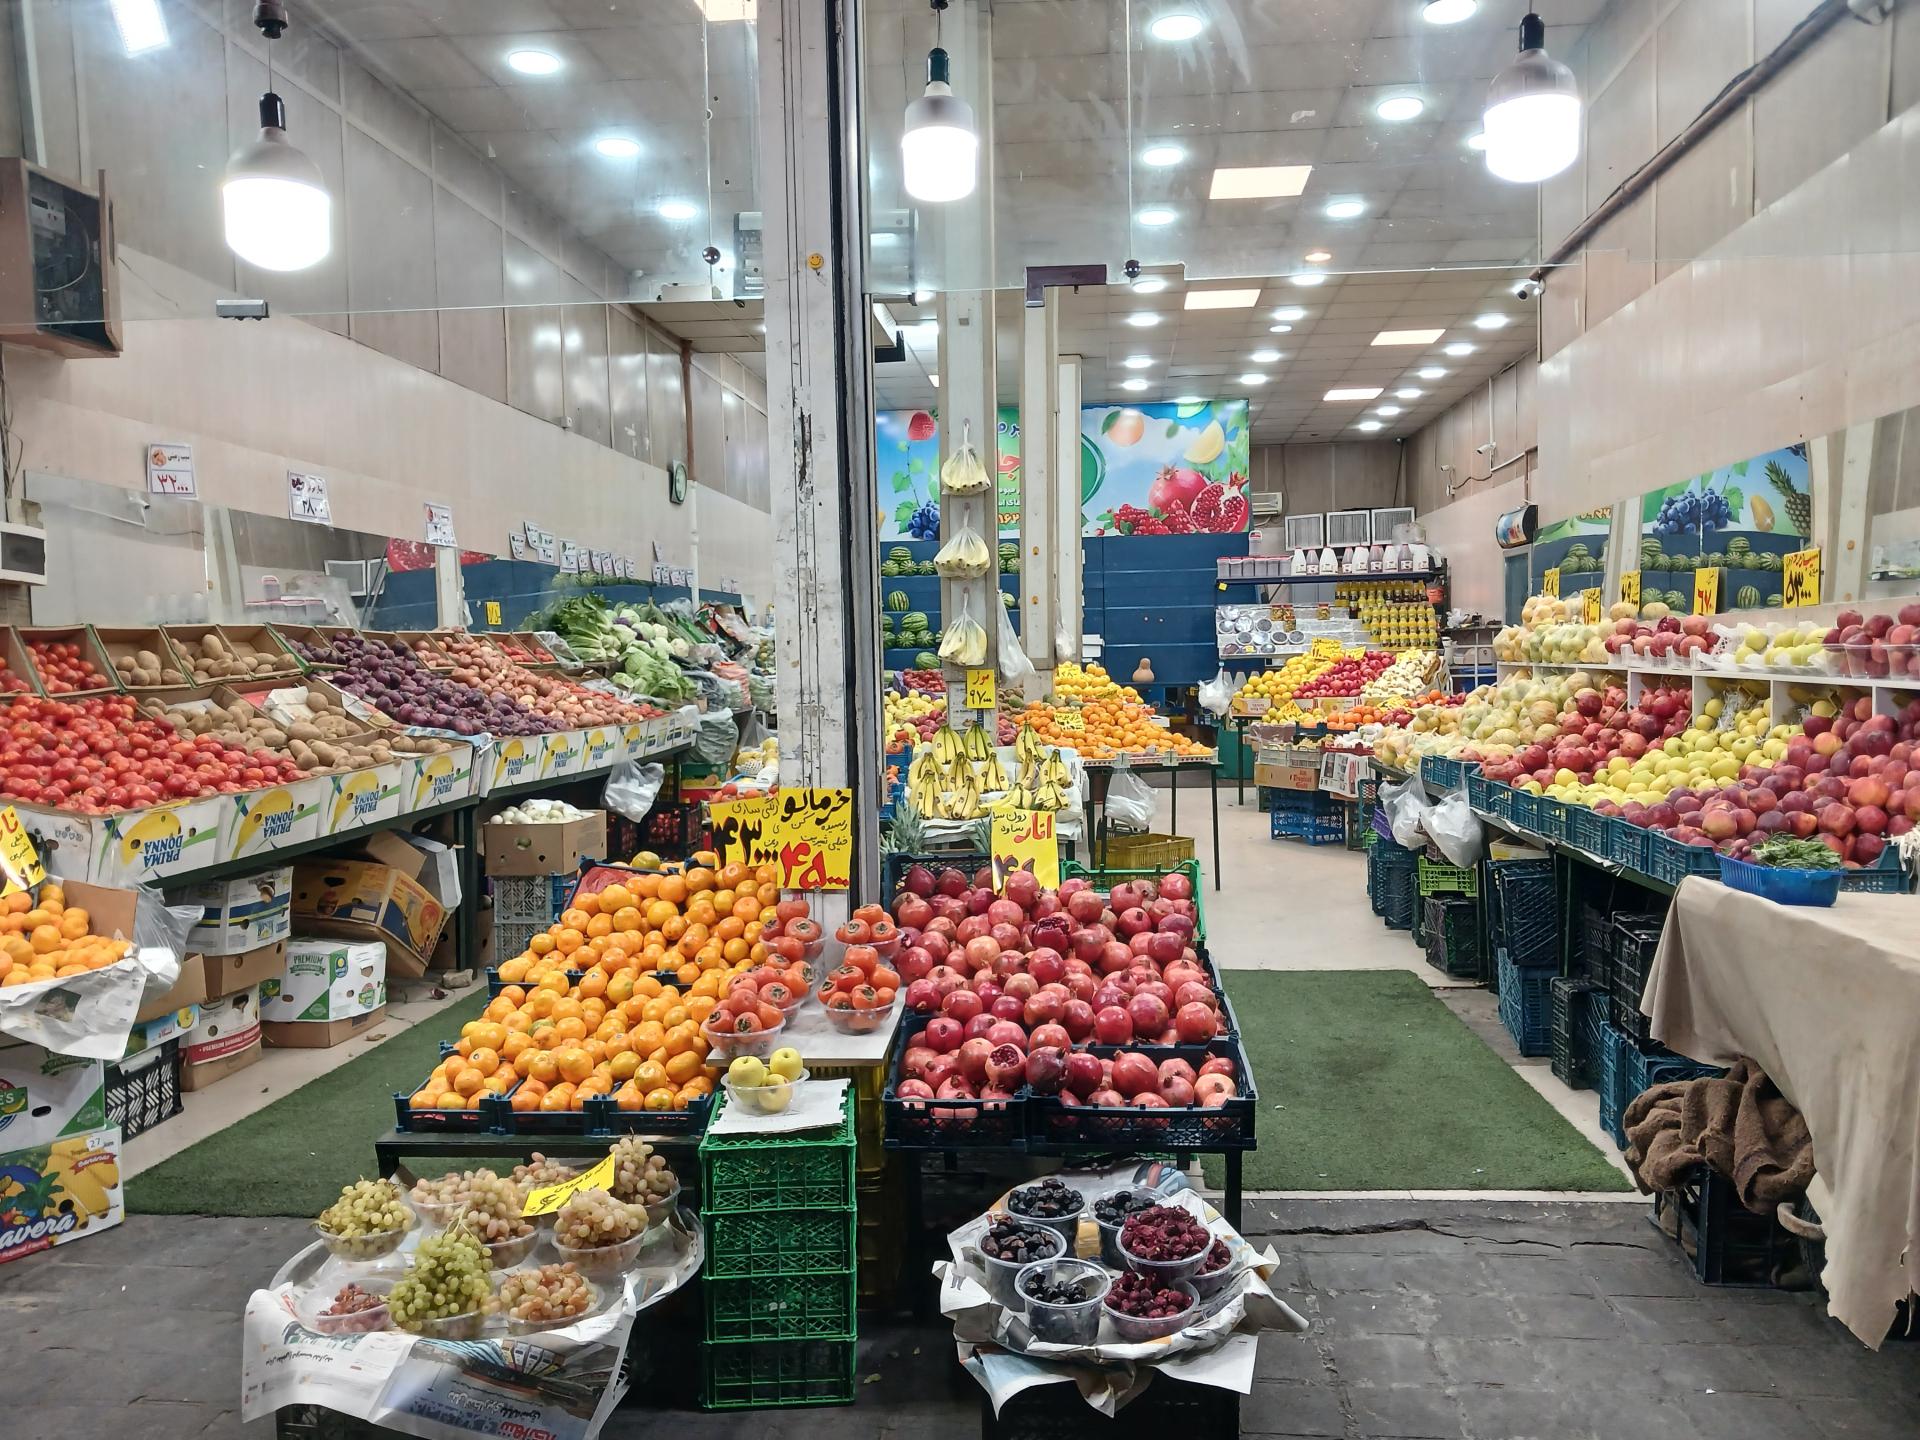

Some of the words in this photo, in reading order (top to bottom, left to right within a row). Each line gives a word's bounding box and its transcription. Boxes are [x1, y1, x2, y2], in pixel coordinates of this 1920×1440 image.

[157, 474, 189, 494] ۳۲۰۰۰
[1786, 570, 1811, 607] ۵۳۰۰۰
[972, 671, 989, 685] موز
[970, 690, 992, 705] ۹۷۰۰۰
[356, 790, 380, 805] DONNA
[781, 787, 850, 825] خرمالو
[354, 801, 378, 815] PRIMA
[264, 809, 295, 828] DONNA
[1014, 812, 1052, 844] انار
[263, 822, 293, 839] PRIMA
[801, 834, 828, 846] شیرین
[144, 835, 183, 856] DONNA
[711, 816, 778, 870] ۴۳۰۰۰
[828, 836, 848, 850] خیلی
[144, 849, 181, 868] PRIMA
[780, 841, 849, 889] ۴۵۰۰۰
[293, 954, 324, 965] PREMIUM
